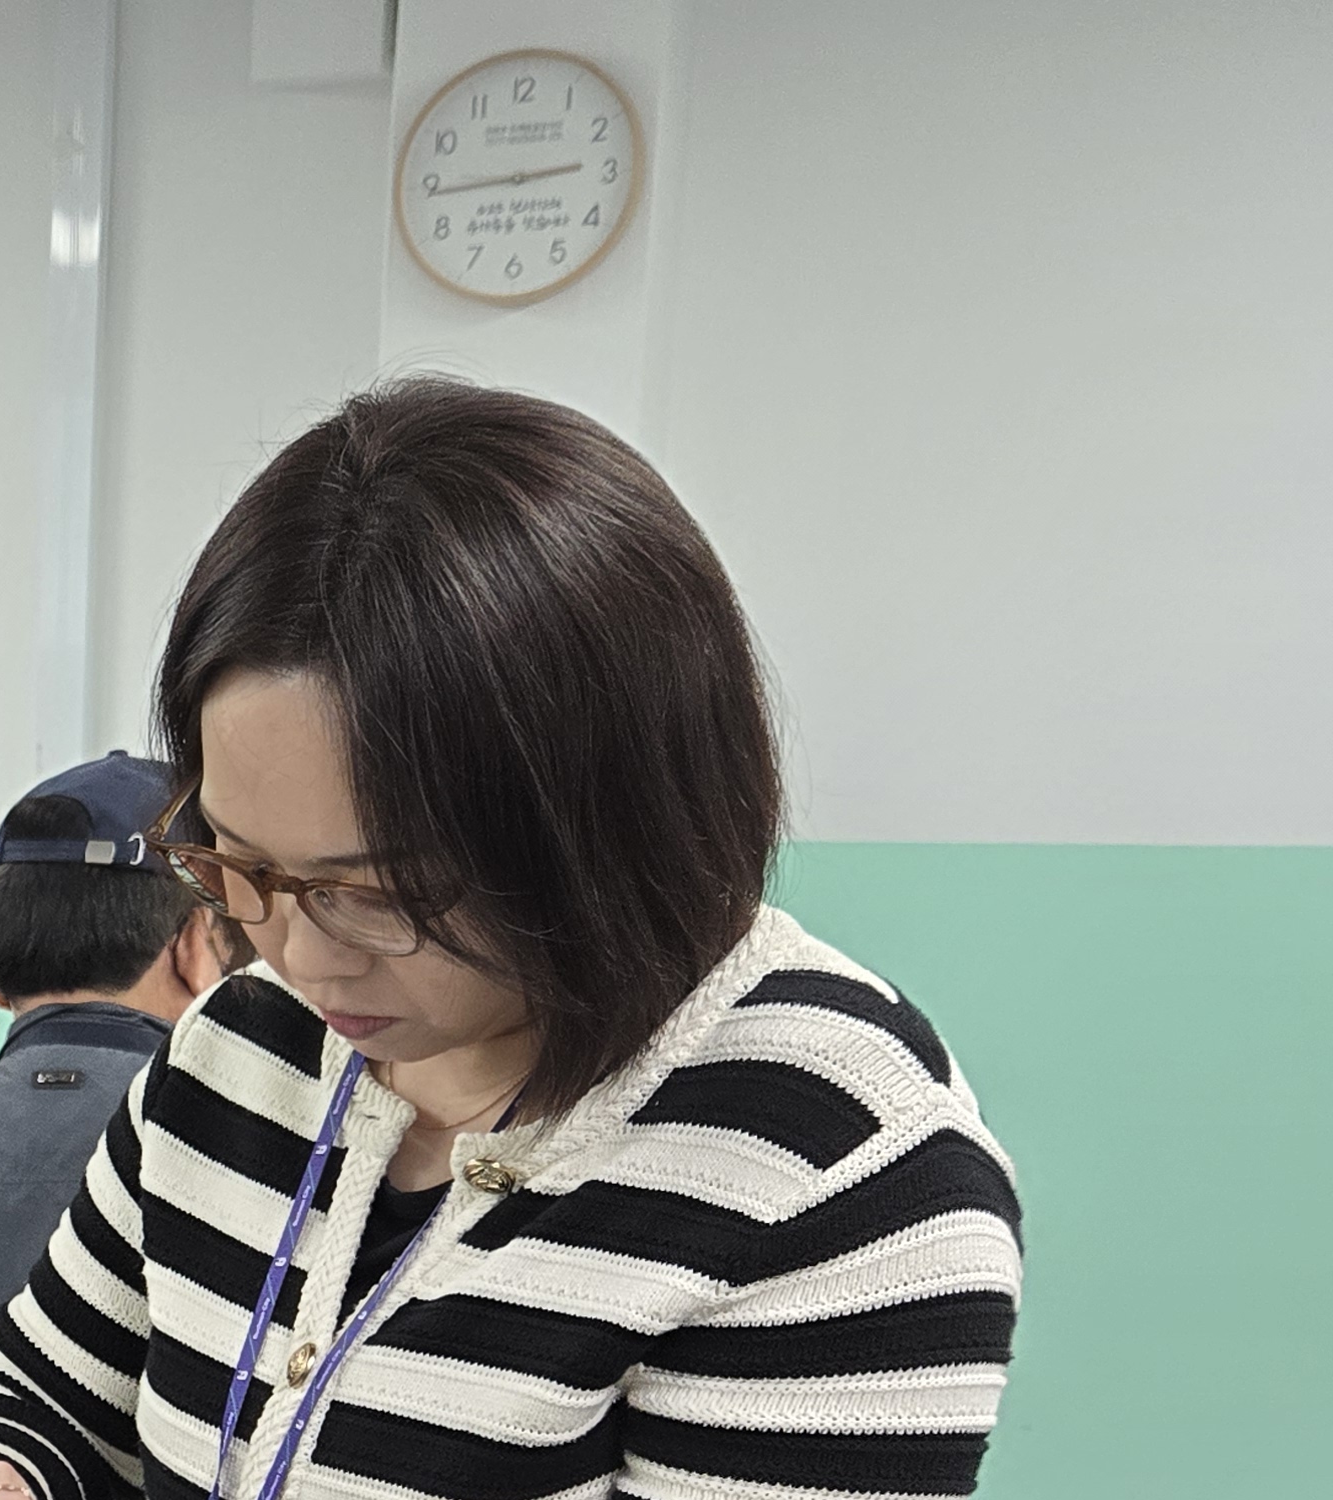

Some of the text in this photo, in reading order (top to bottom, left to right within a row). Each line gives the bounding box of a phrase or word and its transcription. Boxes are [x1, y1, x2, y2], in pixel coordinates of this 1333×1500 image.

[513, 77, 536, 105] 12
[566, 85, 573, 110] 1
[471, 94, 488, 120] 11
[435, 129, 458, 156] 10
[590, 117, 609, 143] 2
[600, 158, 619, 184] 3
[422, 173, 440, 197] 9
[434, 216, 451, 240] 8
[582, 203, 600, 228] 4
[466, 244, 485, 271] 7
[549, 237, 567, 264] 5
[504, 253, 523, 280] 6
